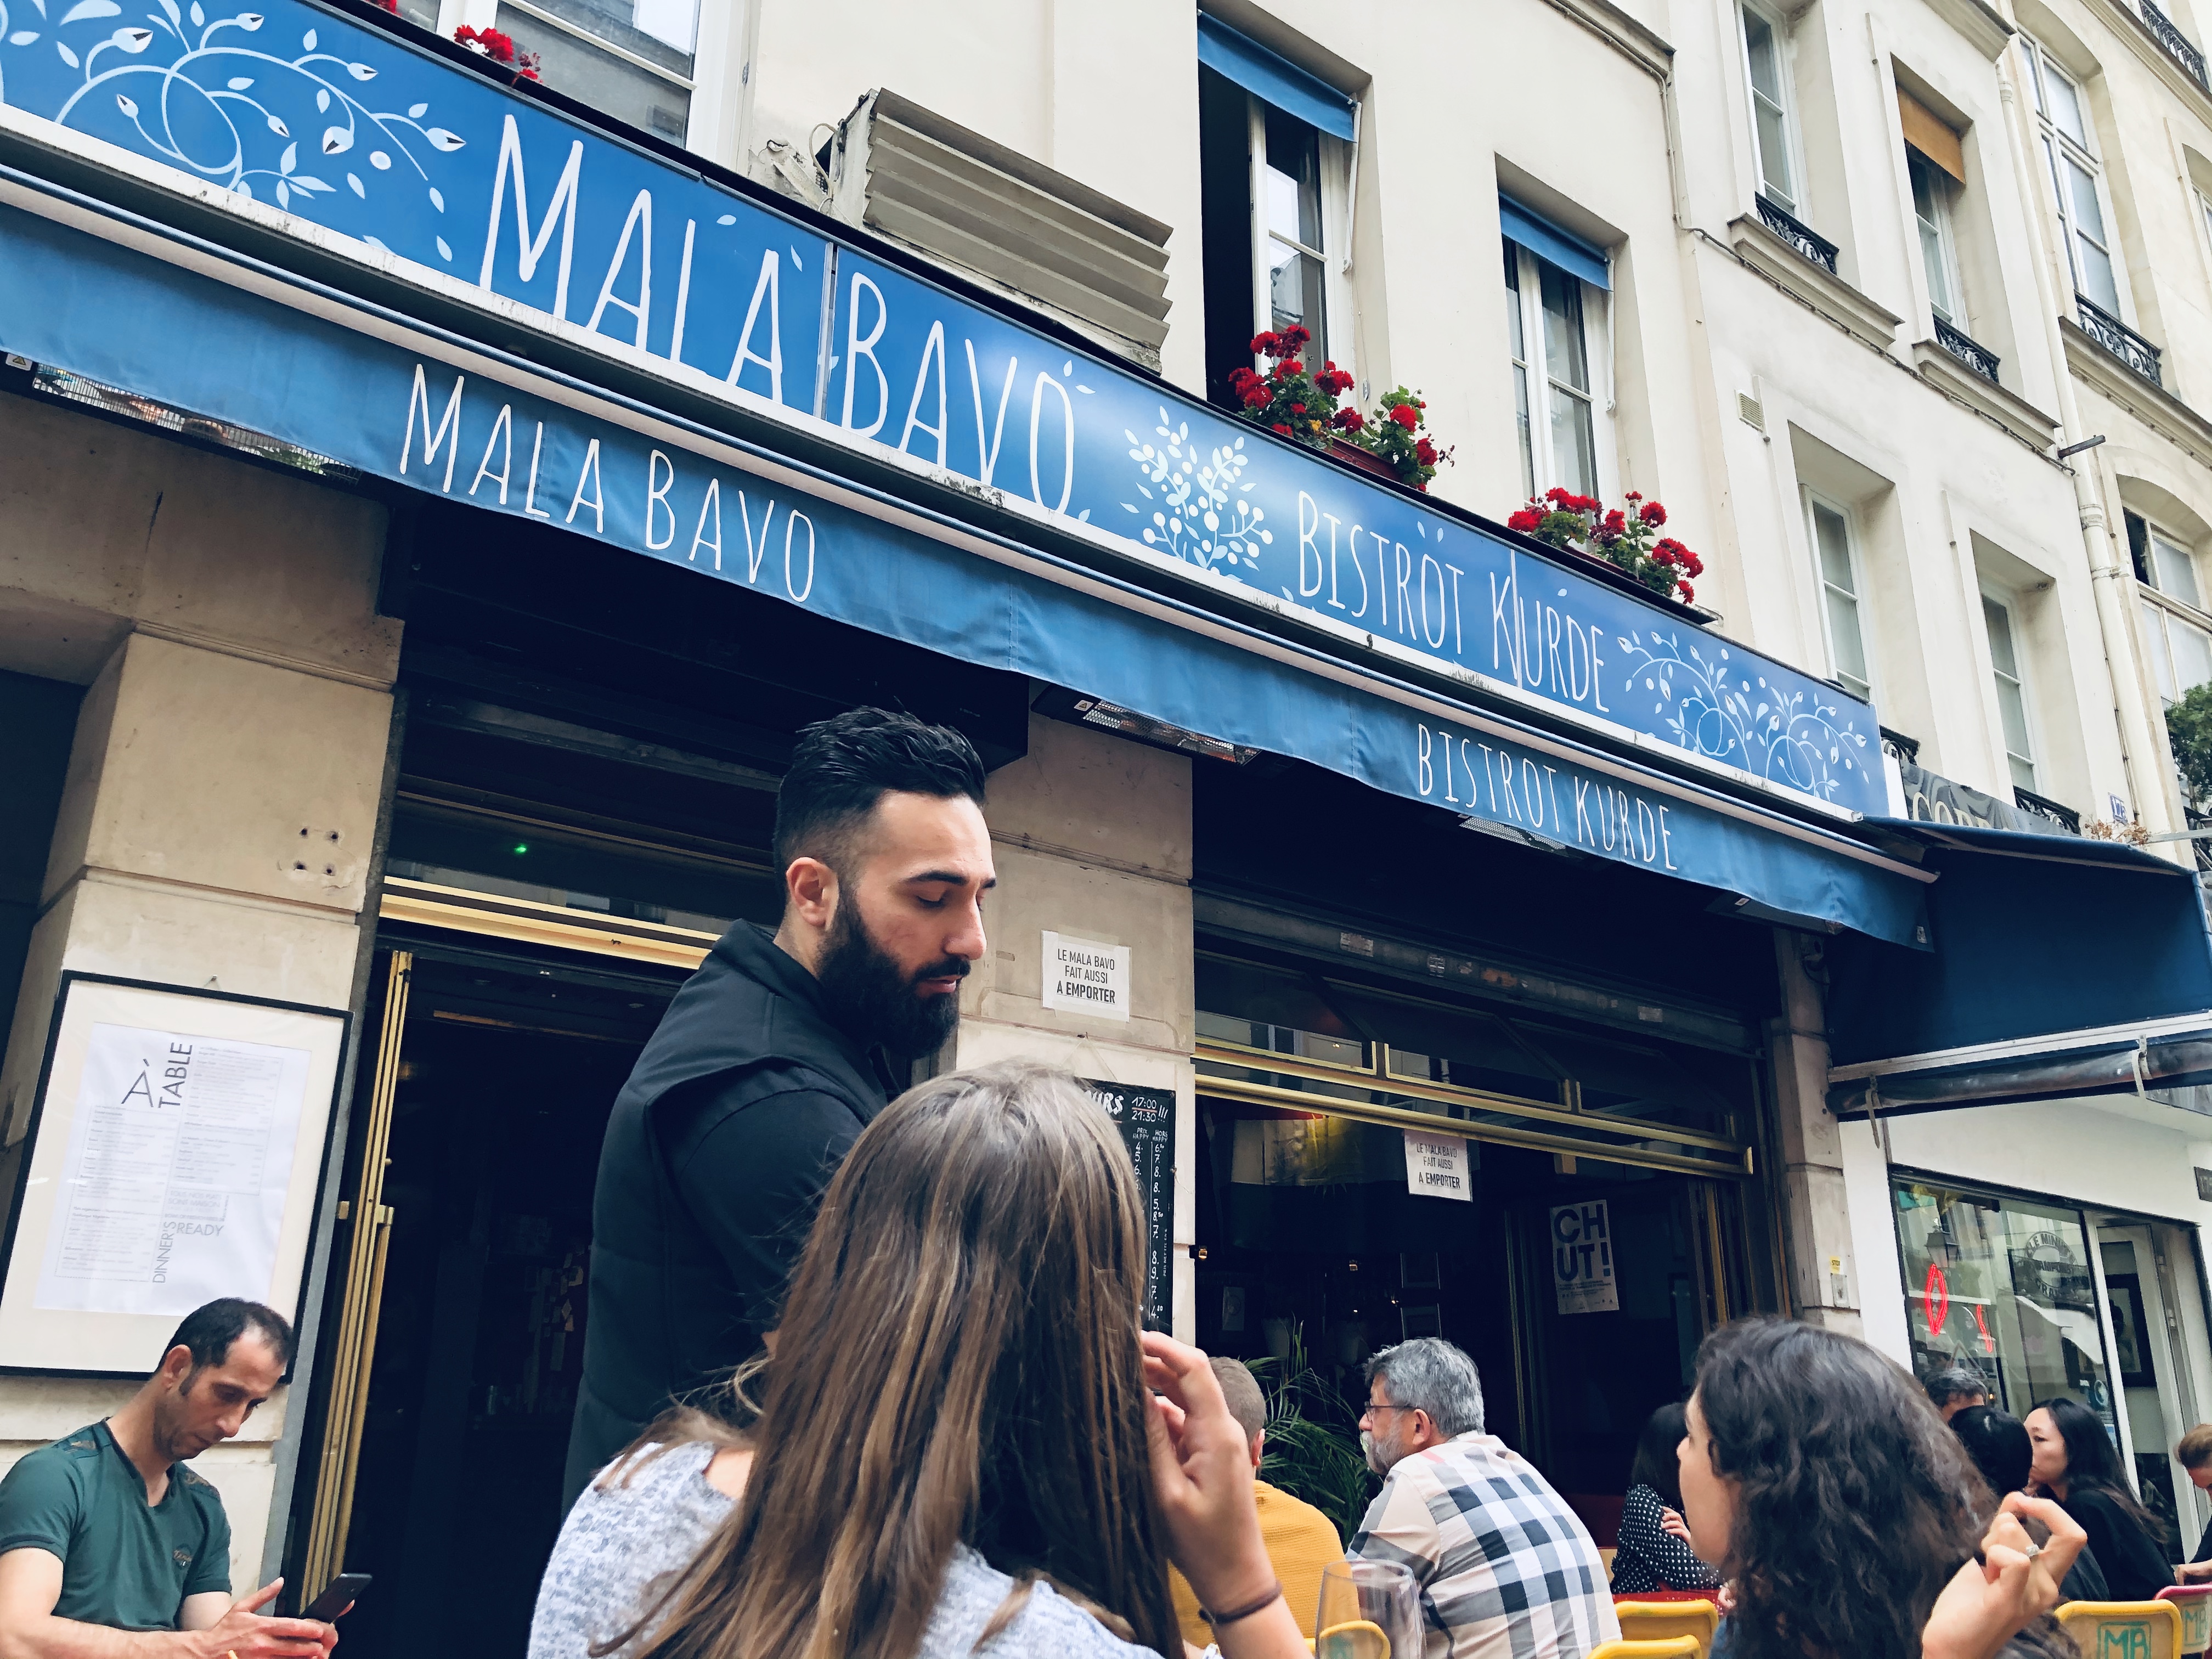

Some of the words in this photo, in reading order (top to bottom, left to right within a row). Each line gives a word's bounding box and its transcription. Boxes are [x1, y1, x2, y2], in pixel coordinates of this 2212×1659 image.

[480, 114, 782, 405] MALA
[841, 272, 1075, 515] BAVO
[399, 363, 603, 533] MALA
[646, 450, 815, 602] BAVO
[1299, 490, 1464, 654] BISTROT
[1491, 571, 1610, 713] KURDE
[1418, 723, 1560, 833] BISTROT
[1575, 776, 1677, 871] KURDE
[1058, 949, 1067, 961] LE
[1070, 951, 1092, 966] MALA
[1094, 956, 1115, 970] BAVO
[1065, 965, 1082, 979] FAIT
[1084, 969, 1108, 984] AUSSI
[1057, 980, 1063, 994] A
[1066, 982, 1115, 1003] EMPORTER
[121, 1058, 154, 1108] À
[158, 1042, 193, 1108] TABLE
[1132, 1096, 1157, 1109] 17:00
[1132, 1110, 1156, 1122] 21:30
[1155, 1129, 1168, 1138] HORS
[1417, 1142, 1424, 1153] LE
[1424, 1144, 1442, 1155] MALA
[1442, 1146, 1458, 1158] BAVO
[1423, 1156, 1436, 1167] FAIT
[1437, 1158, 1453, 1170] AUSSI
[1419, 1172, 1424, 1183] A
[1425, 1172, 1460, 1189] EMPORTER
[176, 1222, 224, 1237] READY
[1554, 1204, 1606, 1243] CH
[153, 1221, 176, 1283] DINNER'S
[1556, 1242, 1611, 1282] UT!
